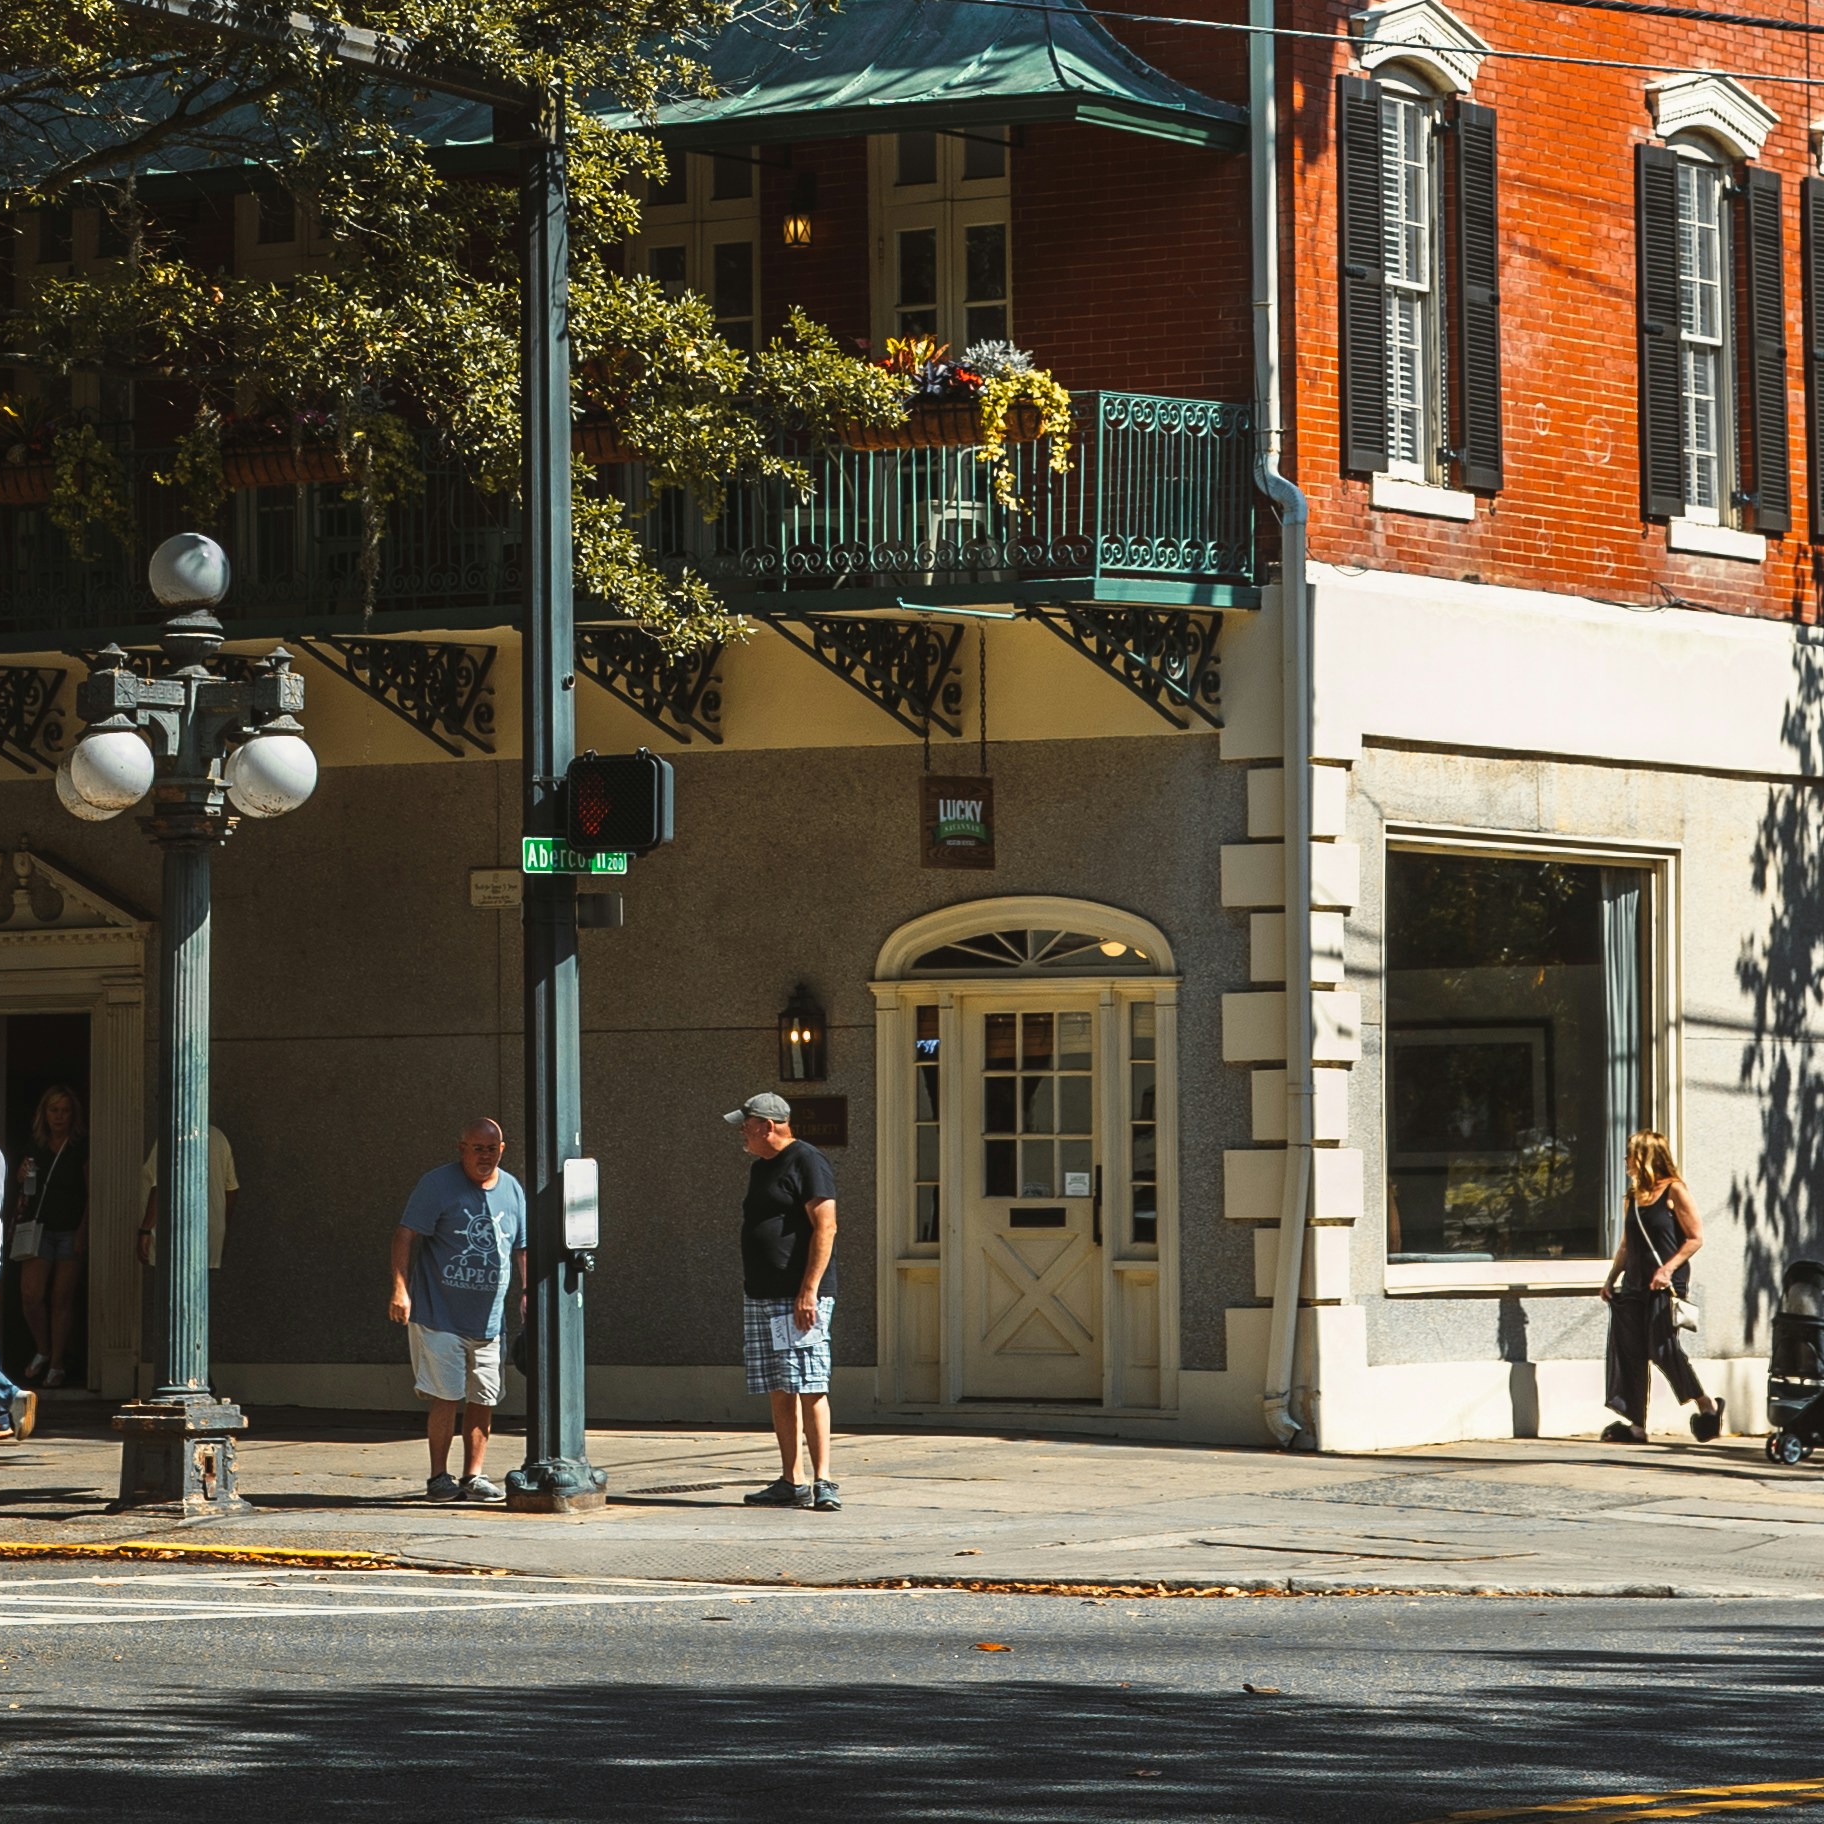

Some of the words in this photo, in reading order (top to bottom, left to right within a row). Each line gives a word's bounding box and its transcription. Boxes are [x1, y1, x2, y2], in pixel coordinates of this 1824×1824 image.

[939, 798, 983, 824] LUCKY
[607, 857, 624, 871] 200
[443, 1264, 486, 1284] CAPE
